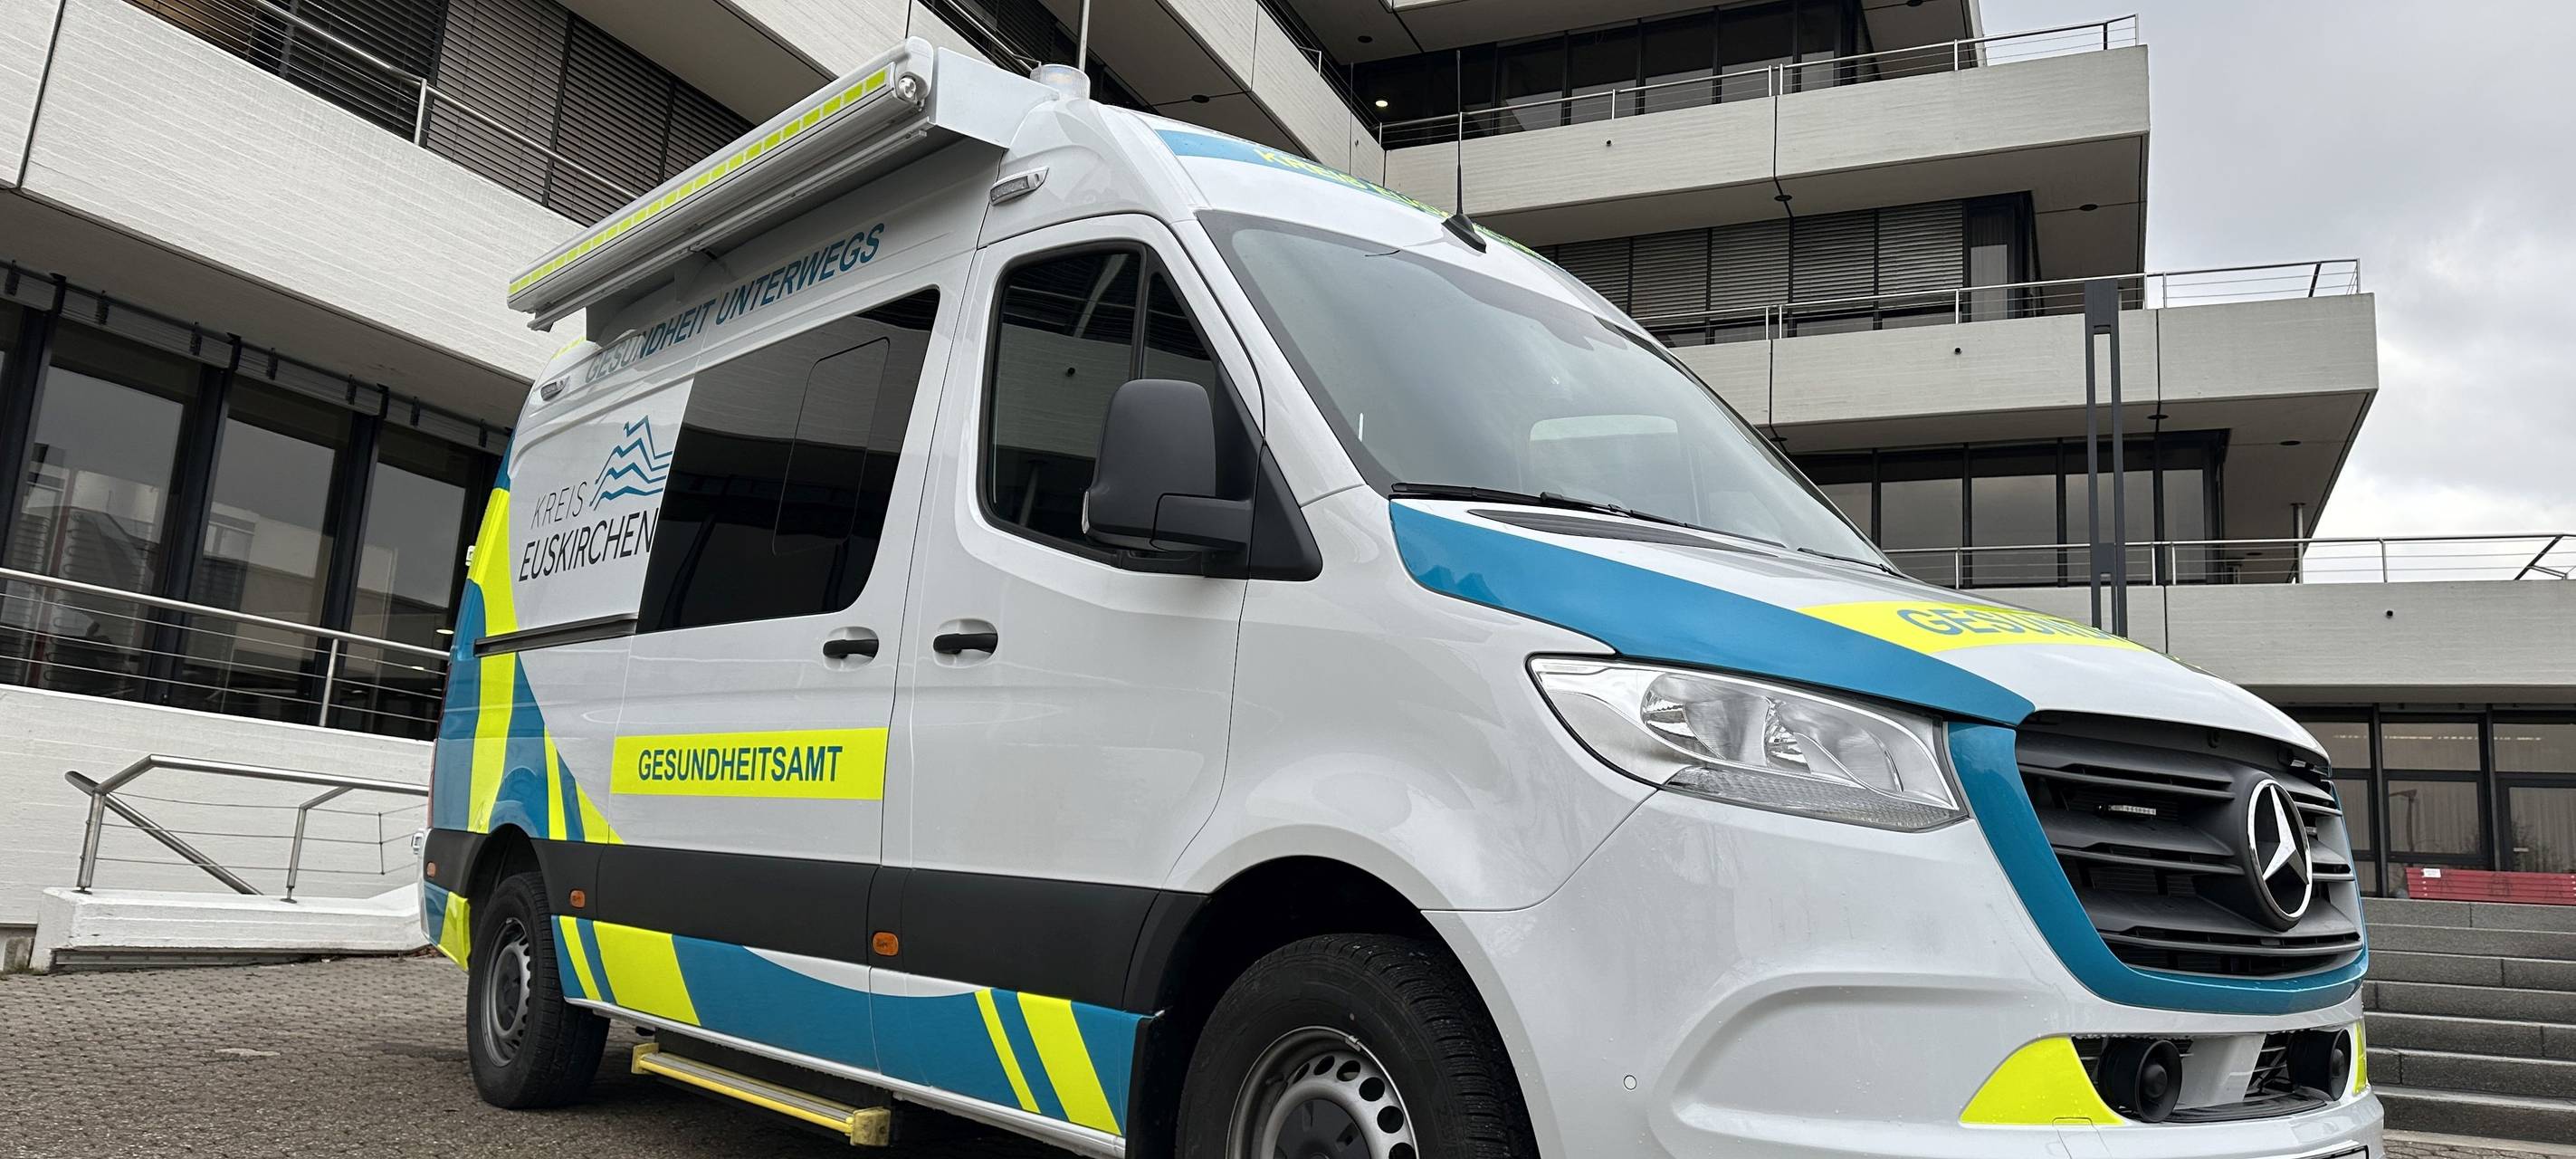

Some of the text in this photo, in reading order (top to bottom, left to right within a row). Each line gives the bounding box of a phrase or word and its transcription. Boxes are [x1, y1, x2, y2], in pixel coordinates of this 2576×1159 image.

[584, 223, 884, 383] GESUNDHEIT UNTERWEGS
[530, 481, 587, 530] KREIS
[519, 507, 659, 582] EUSKIRCHEN
[638, 745, 843, 782] GESUNDHEITSAMT
